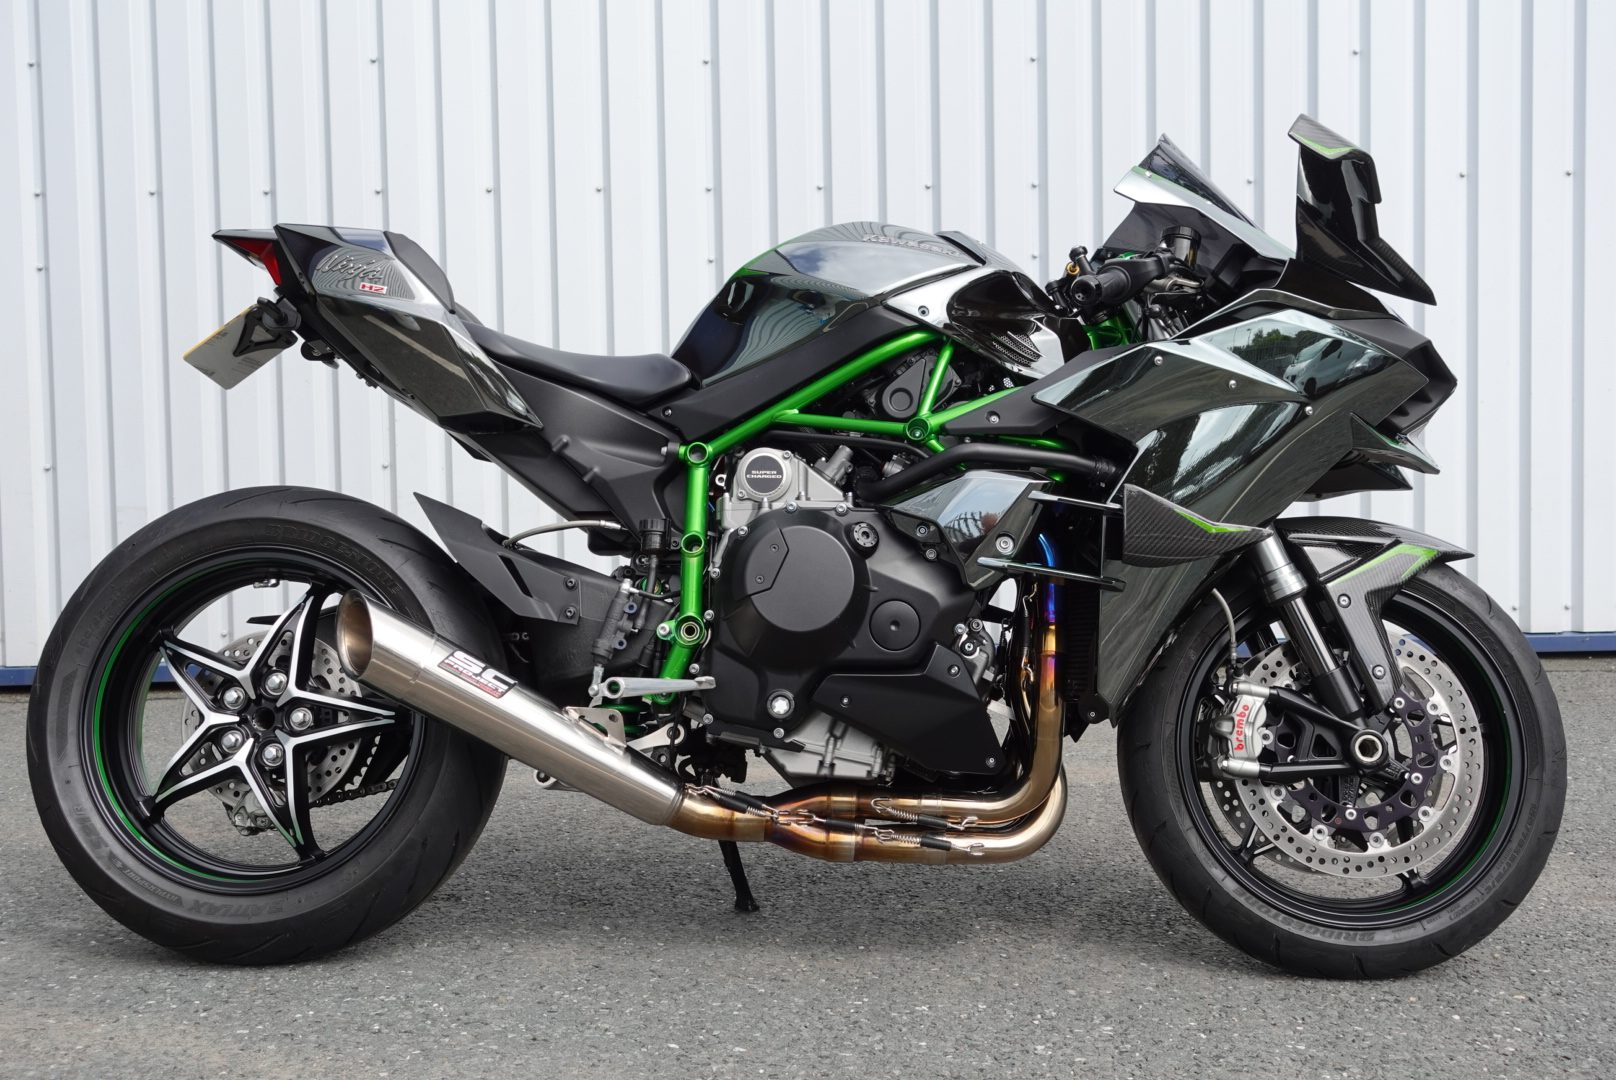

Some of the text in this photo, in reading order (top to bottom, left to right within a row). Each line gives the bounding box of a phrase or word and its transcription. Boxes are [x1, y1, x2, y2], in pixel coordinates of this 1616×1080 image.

[315, 255, 382, 281] Ninja
[361, 284, 384, 292] H2
[443, 659, 506, 694] PROJECT
[447, 650, 518, 691] SC
[1233, 704, 1250, 751] brembo
